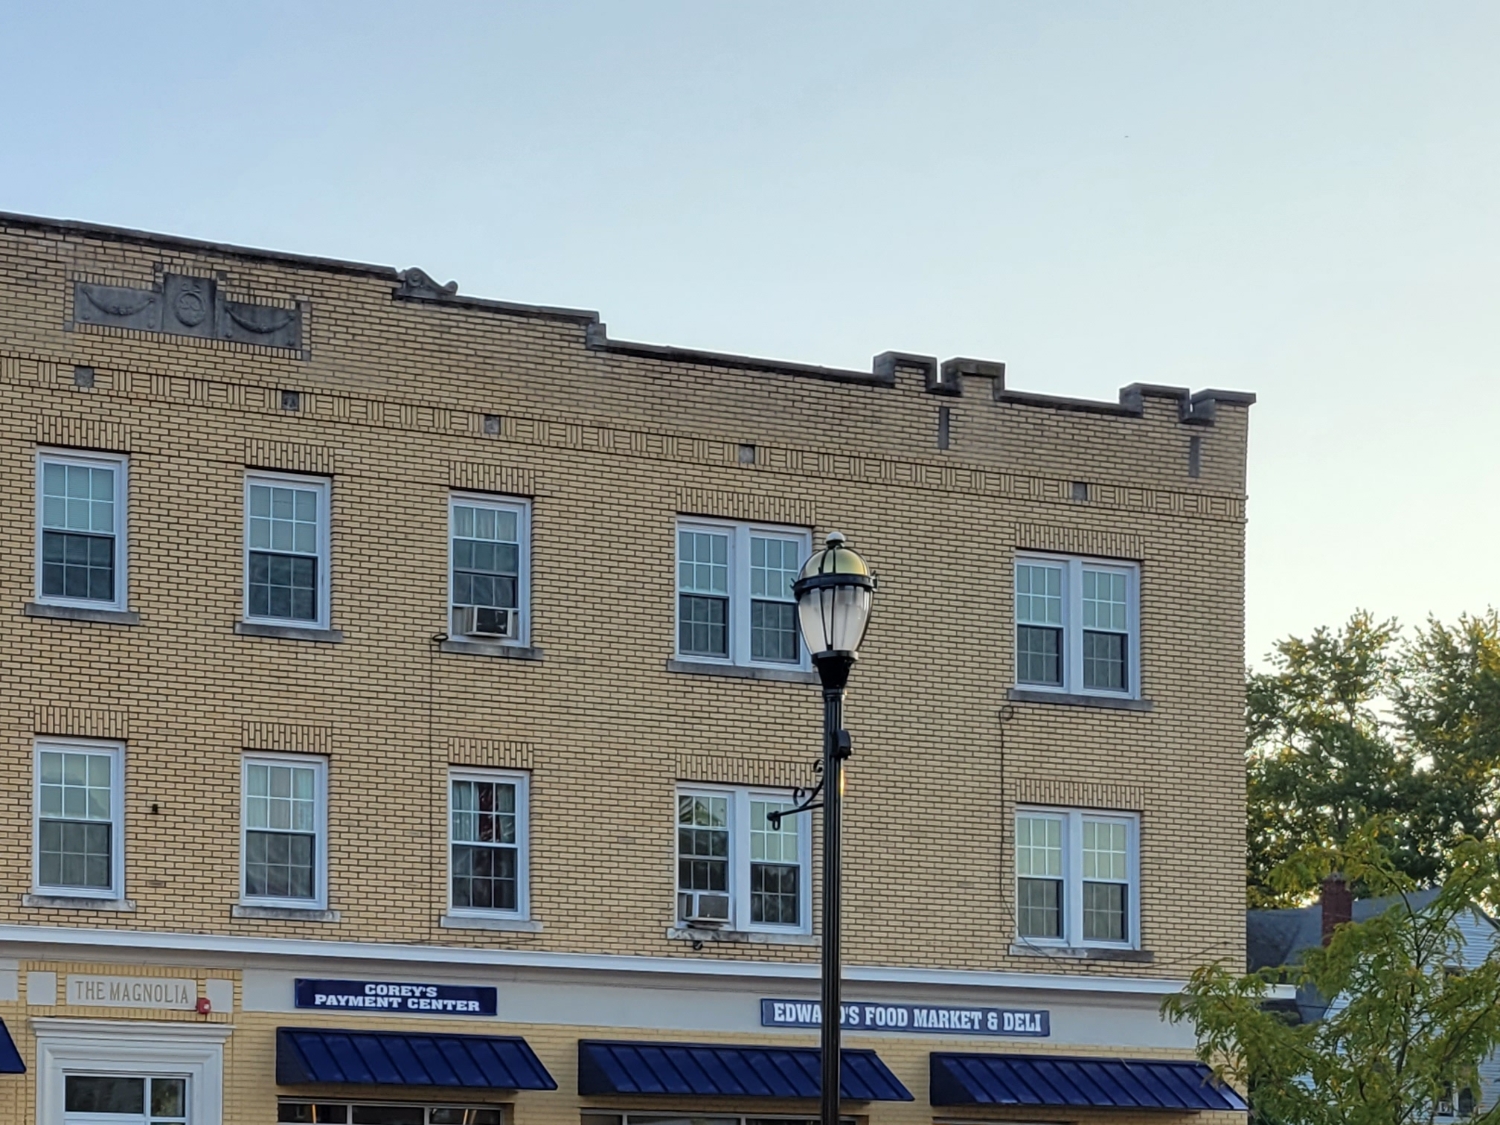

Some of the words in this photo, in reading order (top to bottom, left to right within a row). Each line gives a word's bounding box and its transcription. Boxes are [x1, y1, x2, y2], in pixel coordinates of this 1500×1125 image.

[75, 981, 105, 1000] THE
[109, 982, 189, 1004] MAGNOLIA
[364, 984, 438, 998] COREY'S
[314, 994, 401, 1009] PAYMENT
[407, 998, 480, 1012] CENTER
[773, 1003, 860, 1026] EDWA'S
[865, 1007, 908, 1028] FOOD
[913, 1009, 982, 1031] MARKET
[987, 1011, 998, 1031] &
[1003, 1012, 1041, 1032] DELI
